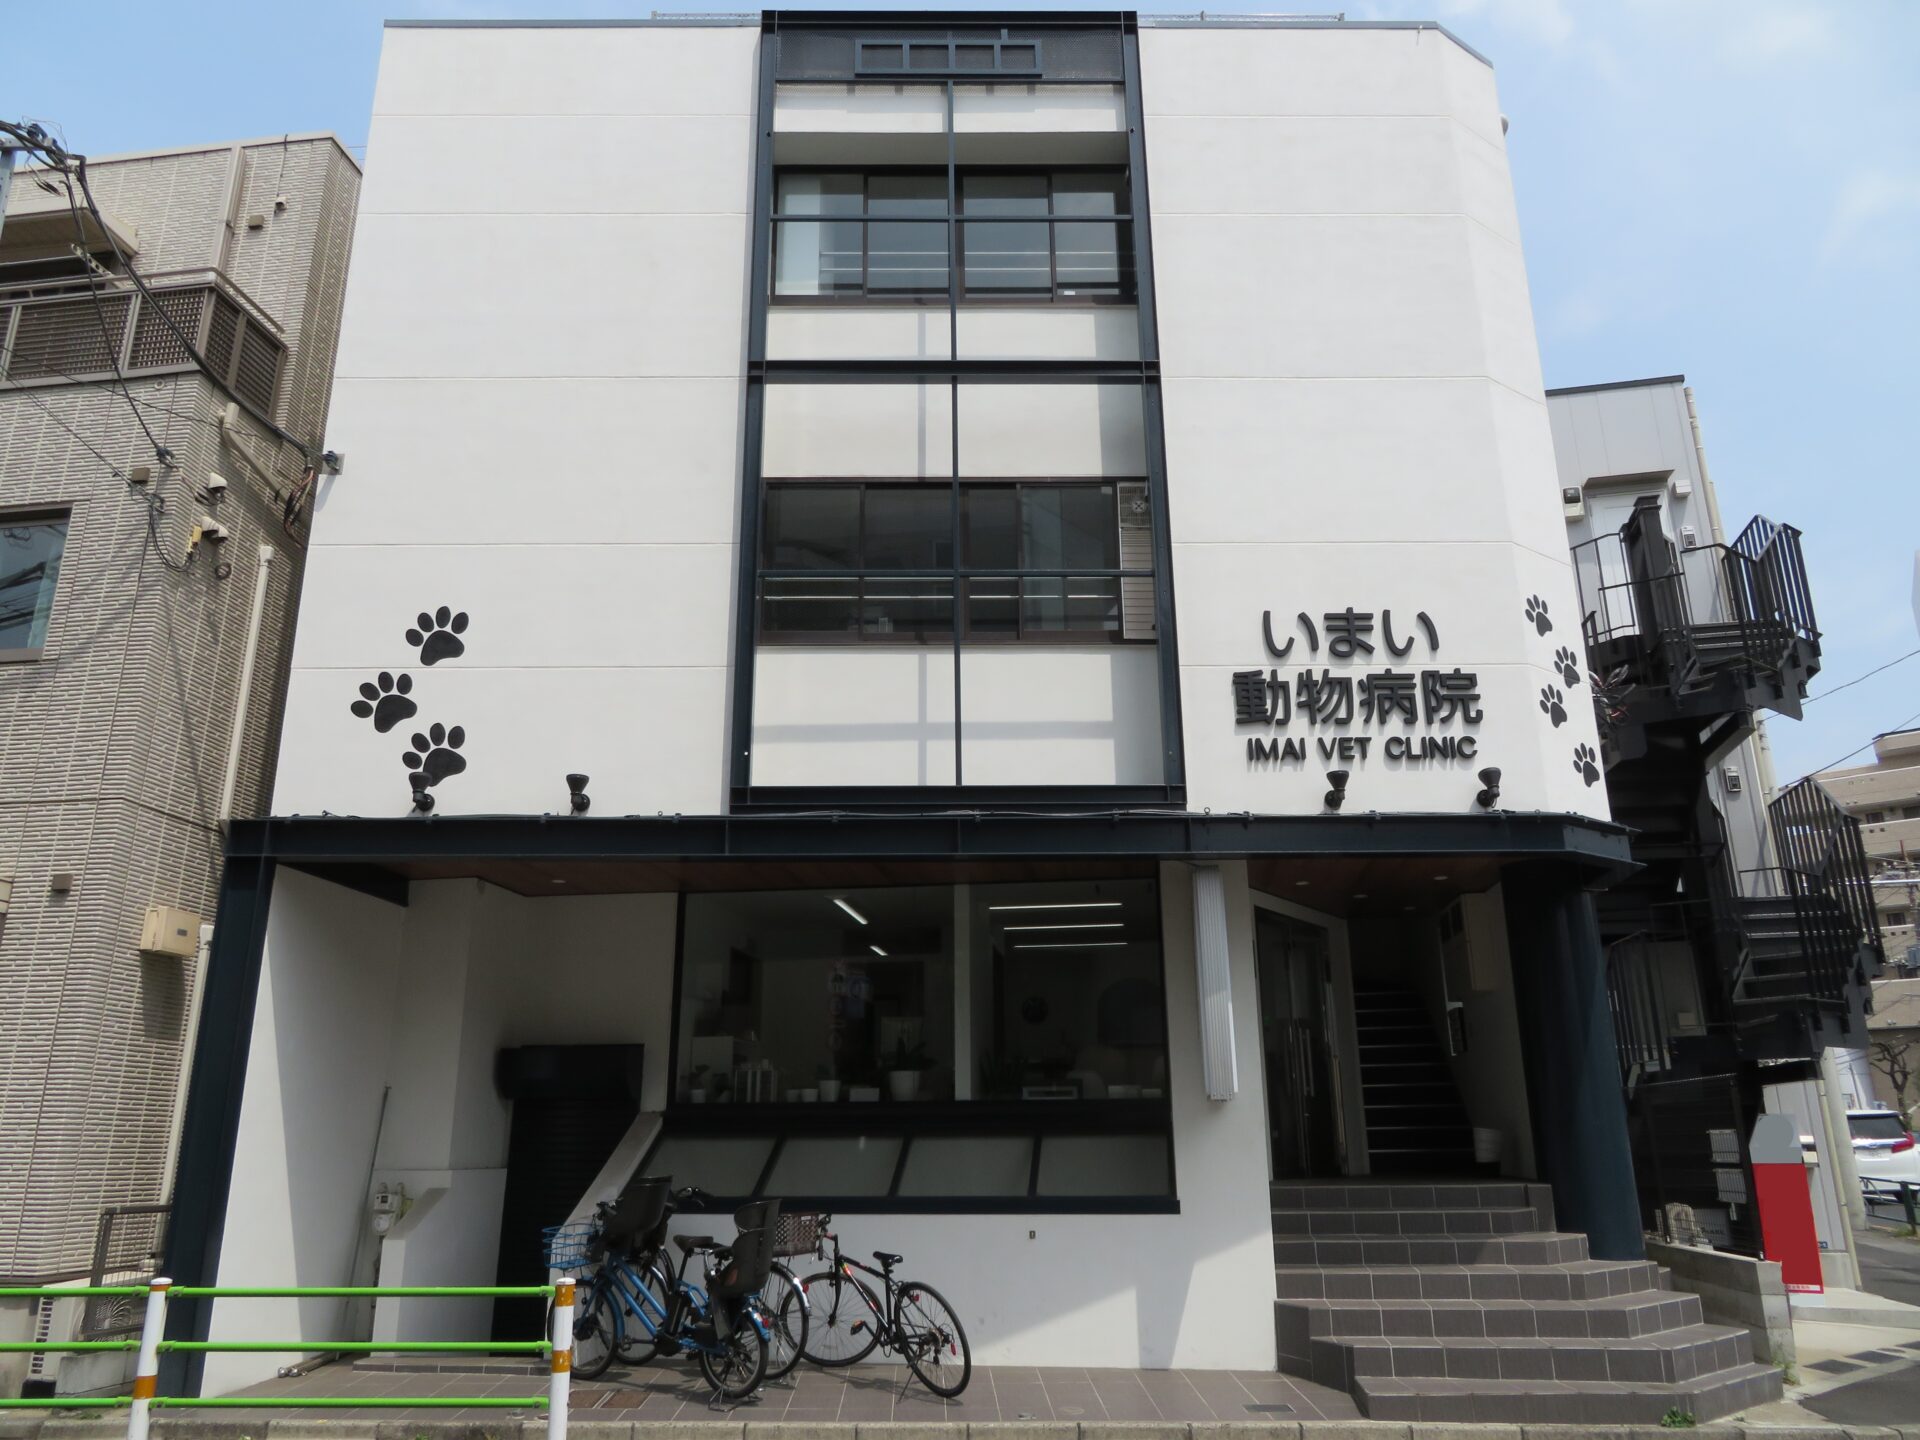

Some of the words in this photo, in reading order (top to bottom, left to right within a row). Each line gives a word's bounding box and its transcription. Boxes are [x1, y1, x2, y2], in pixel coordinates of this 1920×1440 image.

[1263, 607, 1440, 657] いまい
[1232, 668, 1483, 726] 動物病院
[1248, 738, 1307, 762] IMAI
[1318, 737, 1372, 762] VET
[1385, 736, 1478, 761] CLINIC
